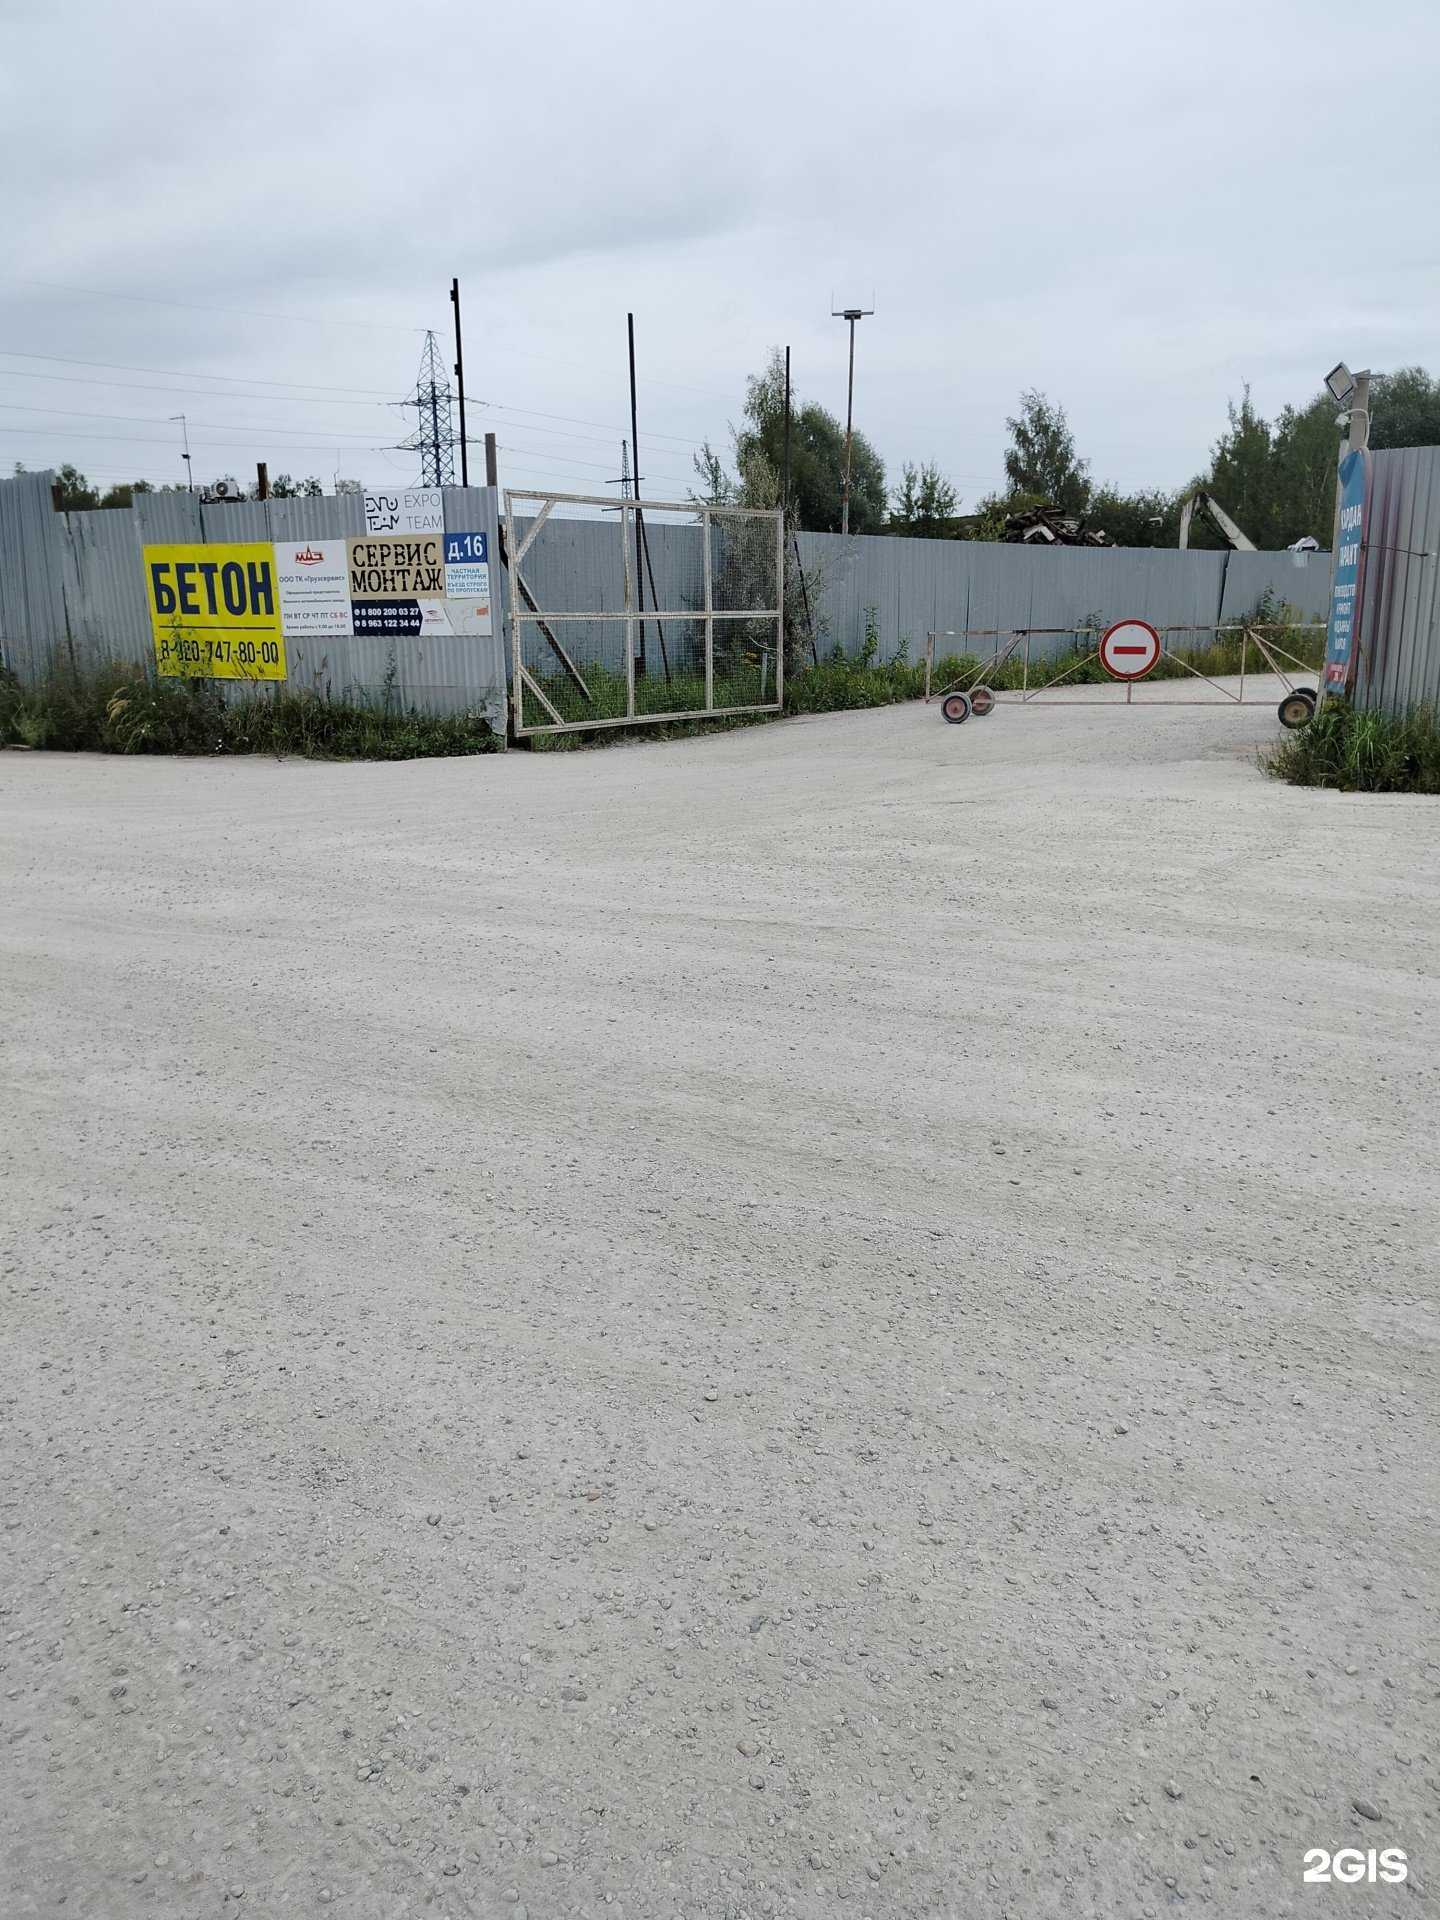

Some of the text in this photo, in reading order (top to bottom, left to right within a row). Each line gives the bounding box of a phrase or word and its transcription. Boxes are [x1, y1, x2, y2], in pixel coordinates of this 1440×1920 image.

[404, 493, 441, 508] EXPO
[406, 514, 442, 529] TEAM
[352, 542, 437, 567] СЕРВИС
[448, 535, 483, 560] д.16
[151, 561, 275, 615] БЕТОН
[352, 568, 443, 592] МОНТАЖ
[361, 608, 367, 616] 8
[409, 607, 419, 616] 27
[361, 619, 367, 627] 8
[384, 619, 398, 627] 122
[399, 619, 409, 627] 34
[410, 619, 420, 627] 44
